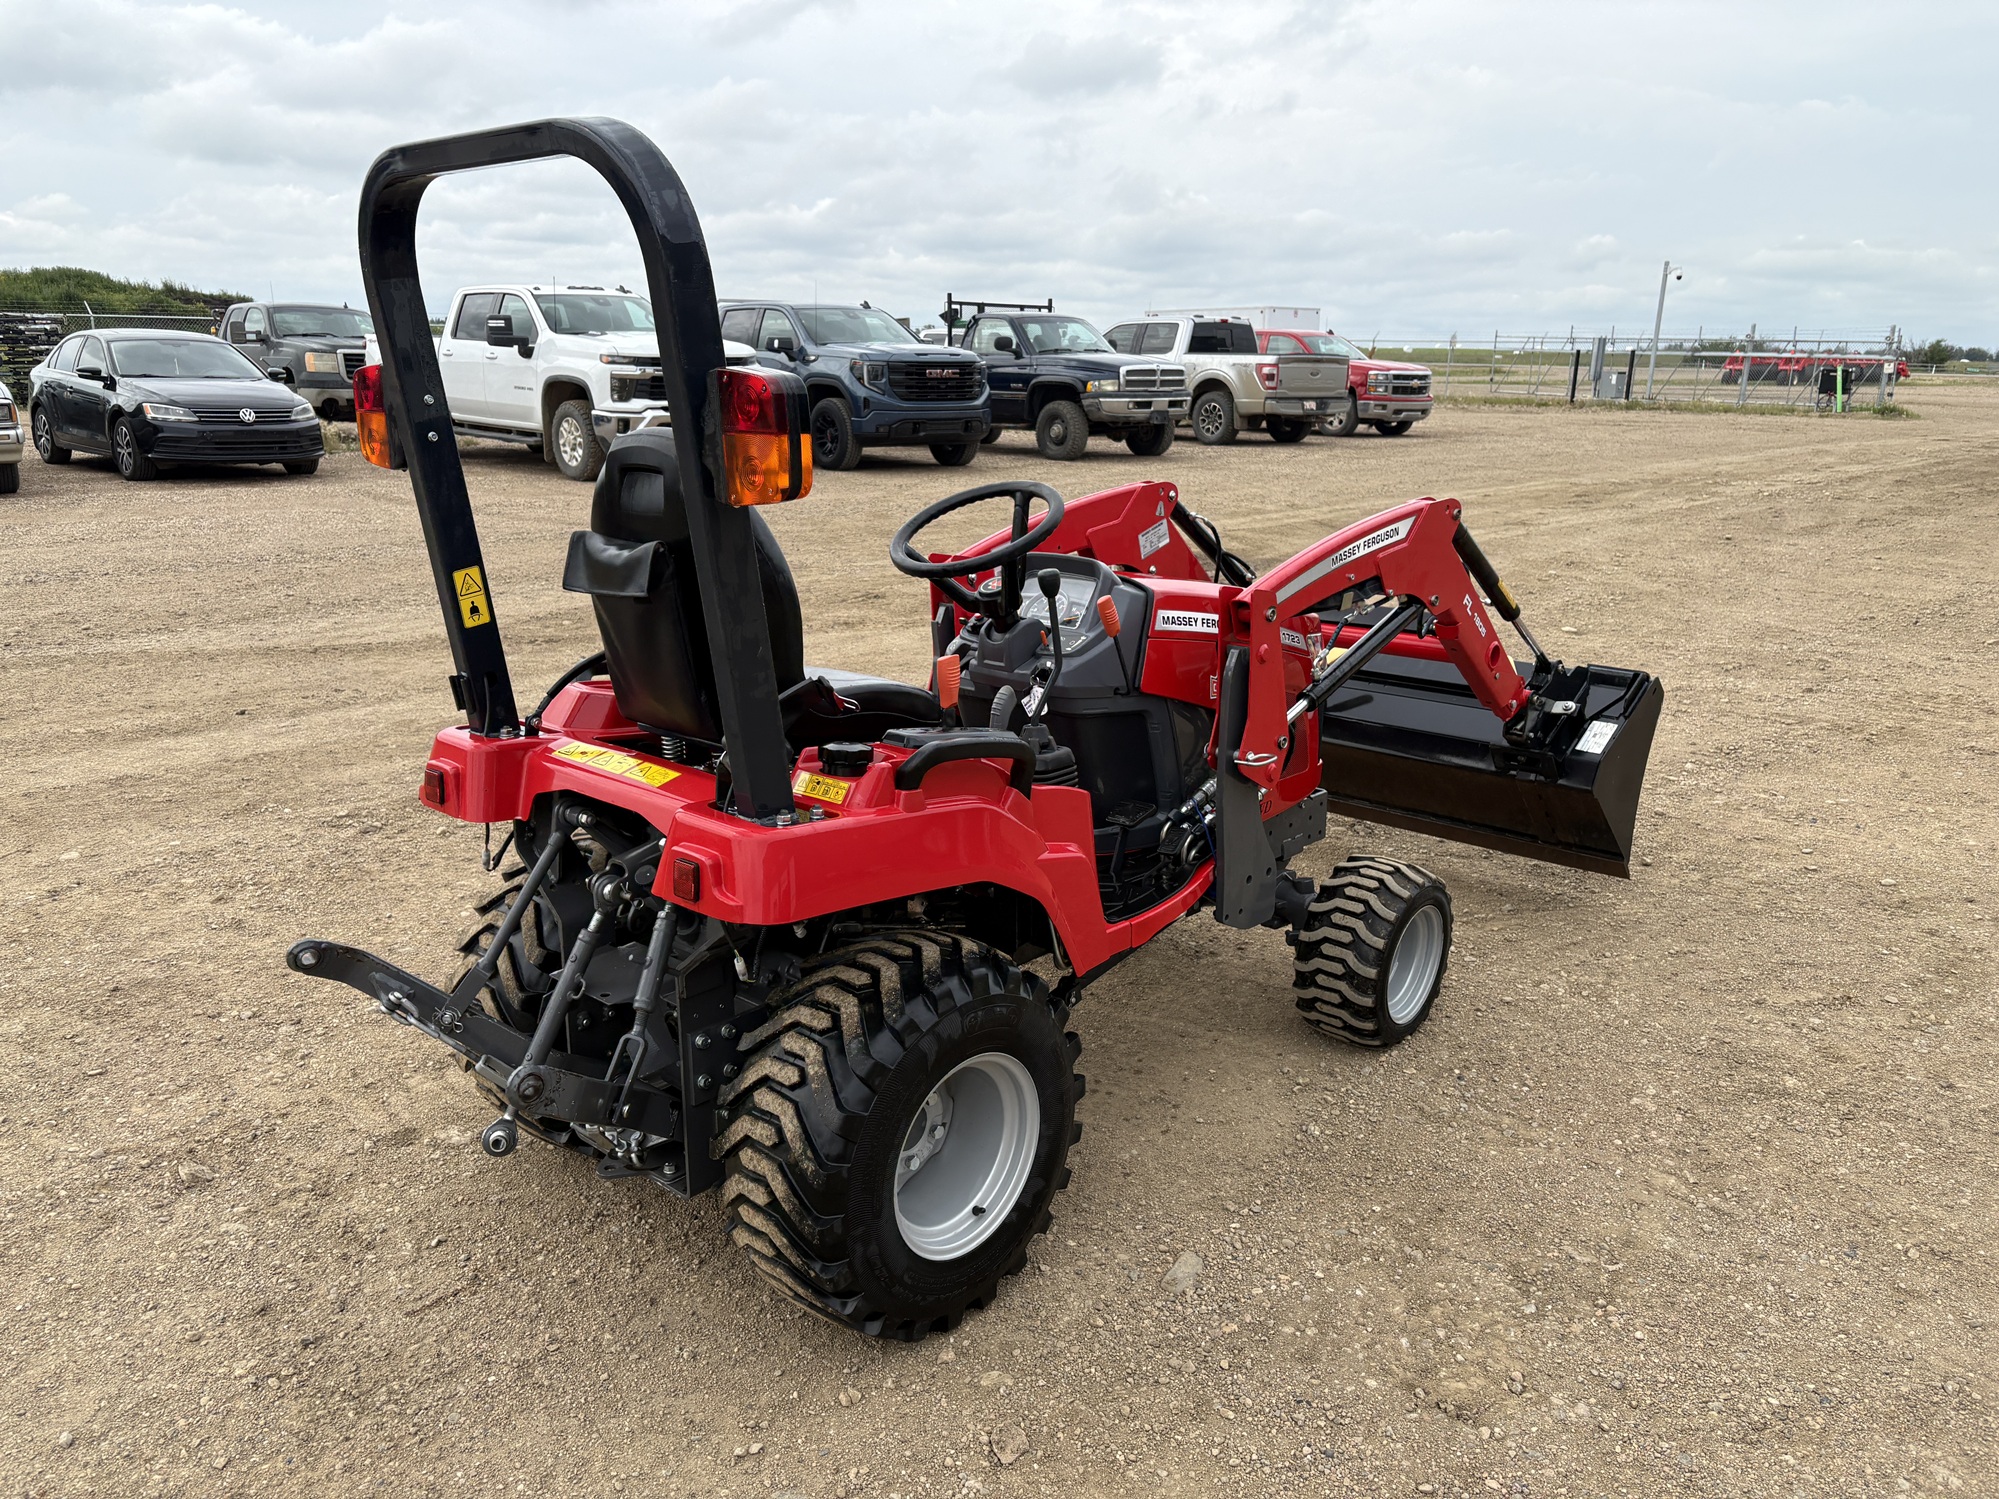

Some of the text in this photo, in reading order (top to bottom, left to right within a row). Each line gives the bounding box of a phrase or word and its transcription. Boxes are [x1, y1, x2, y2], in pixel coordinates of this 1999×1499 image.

[926, 369, 960, 378] GMC
[1332, 526, 1400, 567] MASSEY FERGUSON
[1463, 594, 1473, 617] FL
[1162, 615, 1199, 627] MASSEY
[1282, 632, 1301, 645] 1723
